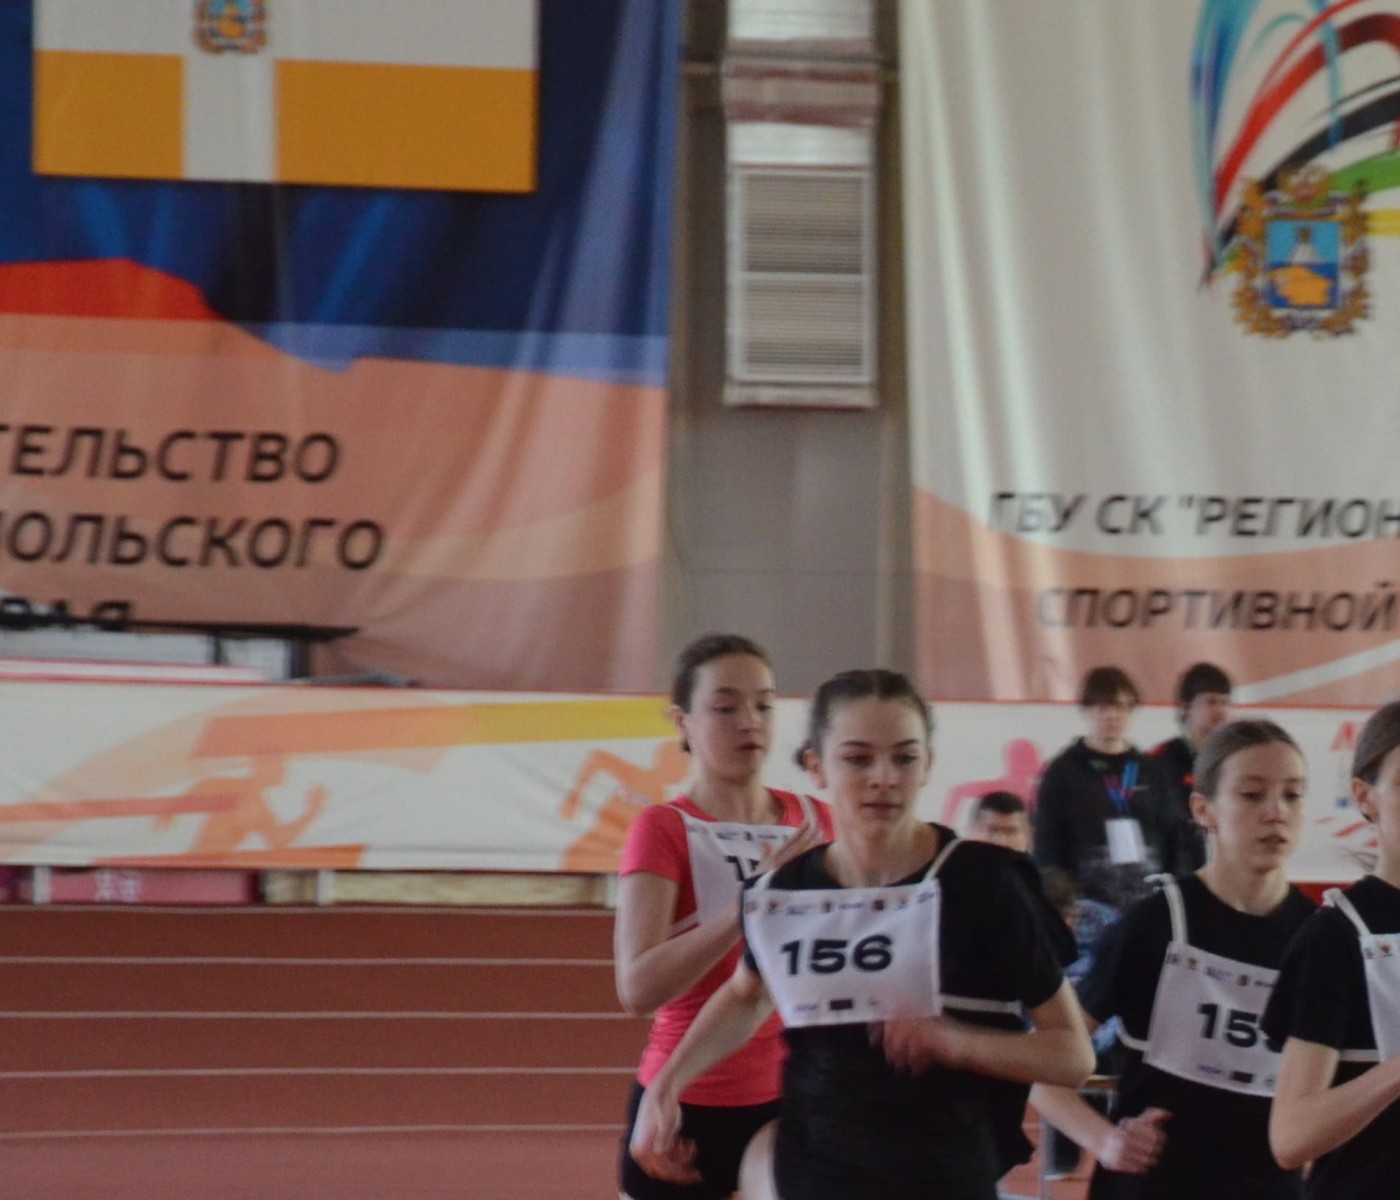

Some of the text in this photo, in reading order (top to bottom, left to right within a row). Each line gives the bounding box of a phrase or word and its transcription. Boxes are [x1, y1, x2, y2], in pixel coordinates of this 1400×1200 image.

[0, 424, 340, 484] ЕЛЬСТВО
[988, 492, 1087, 536] ГБУ
[1095, 494, 1168, 537] СК
[0, 511, 384, 570] ОЛЬСКОГО
[1037, 581, 1400, 632] СПОРТИВНОЙ
[781, 934, 893, 976] 156
[1198, 1002, 1282, 1054] 15
